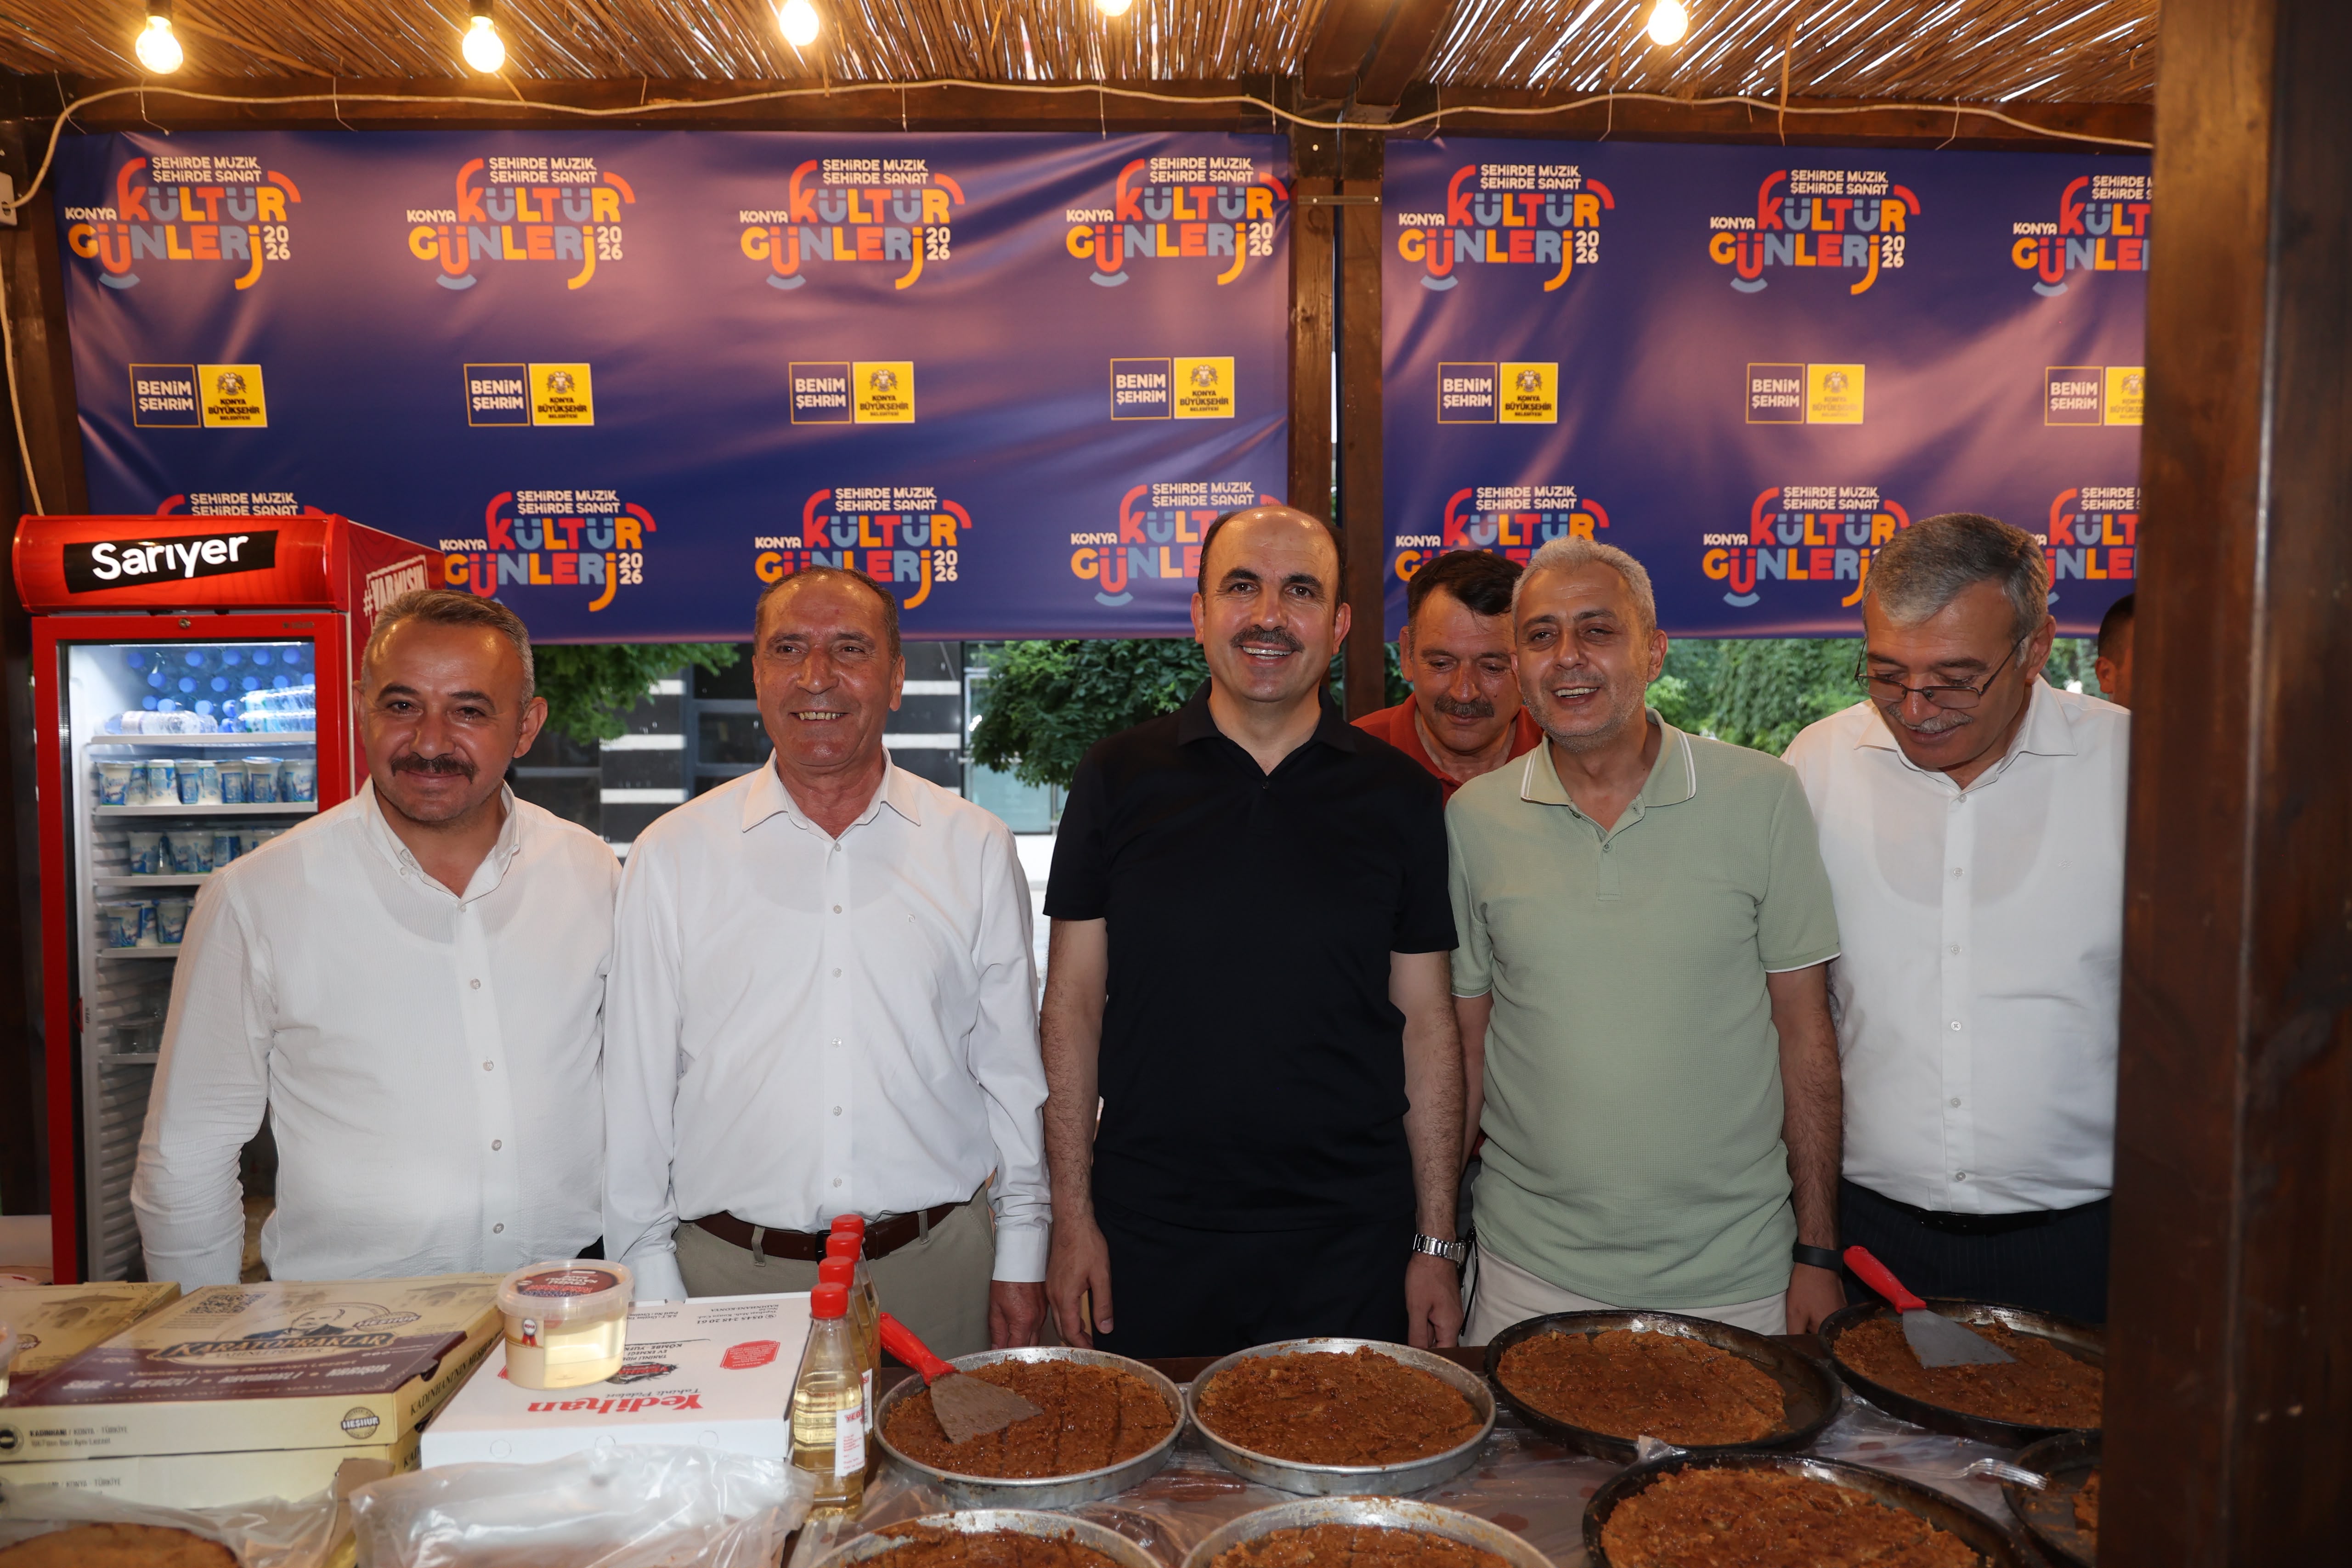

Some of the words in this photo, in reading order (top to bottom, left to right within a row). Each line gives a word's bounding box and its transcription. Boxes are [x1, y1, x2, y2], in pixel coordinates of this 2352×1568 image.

[215, 171, 261, 182] SANAT
[551, 171, 597, 183] SANAT
[883, 173, 928, 184] SANAT
[1210, 170, 1254, 182] SANAT
[117, 158, 287, 222] KÜLTÜR
[456, 158, 621, 222] KÜLTÜR
[1116, 158, 1273, 221] KÜLTÜR
[1538, 178, 1582, 190] SANAT
[1846, 183, 1888, 195] SANAT
[789, 160, 950, 224] KÜLTÜR
[1447, 164, 1600, 227] KÜLTÜR
[1758, 170, 1906, 232] KÜLTÜR
[65, 207, 117, 220] KONYA
[407, 210, 456, 223] KONYA
[740, 210, 788, 223] KONYA
[1066, 210, 1114, 222] KONYA
[1399, 213, 1445, 226] KONYA
[1710, 217, 1755, 229] KONYA
[2013, 223, 2057, 235] KONYA
[2012, 237, 2150, 283] GÜNLE
[137, 380, 192, 395] BENİM
[471, 380, 522, 395] BENİM
[795, 378, 845, 392] BENİM
[1116, 374, 1165, 389] BENİM
[1443, 378, 1492, 392] BENİM
[1752, 379, 1799, 393] BENİM
[2051, 382, 2098, 395] BENİM
[139, 397, 194, 412] ŞEHRİM
[472, 396, 524, 412] ŞEHRİM
[796, 395, 846, 409] ŞEHRİM
[1116, 390, 1166, 405] ŞEHRİM
[1443, 395, 1492, 409] ŞEHRİM
[1752, 395, 1799, 409] ŞEHRİM
[2051, 397, 2097, 411] ŞEHRİM
[893, 500, 937, 511] SANAT
[1211, 494, 1254, 505] SANAT
[1534, 498, 1577, 510] SANAT
[1838, 499, 1879, 510] SANAT
[254, 506, 298, 515] SANAT
[577, 502, 621, 514] SANAT
[485, 491, 643, 550] KÜLTÜR
[803, 489, 957, 547] KÜLTÜR
[1750, 487, 1896, 546] KÜLTÜR
[2049, 488, 2140, 545] KÜLTÜR
[439, 539, 487, 551] KONYA
[755, 537, 801, 548] KONYA
[1071, 533, 1117, 545] KONYA
[1396, 536, 1441, 547] KONYA
[1703, 534, 1748, 546] KONYA
[91, 536, 249, 580] Sarıyer
[167, 1334, 389, 1356] KARATOPRAKLAR
[527, 1394, 703, 1414] Yedihan
